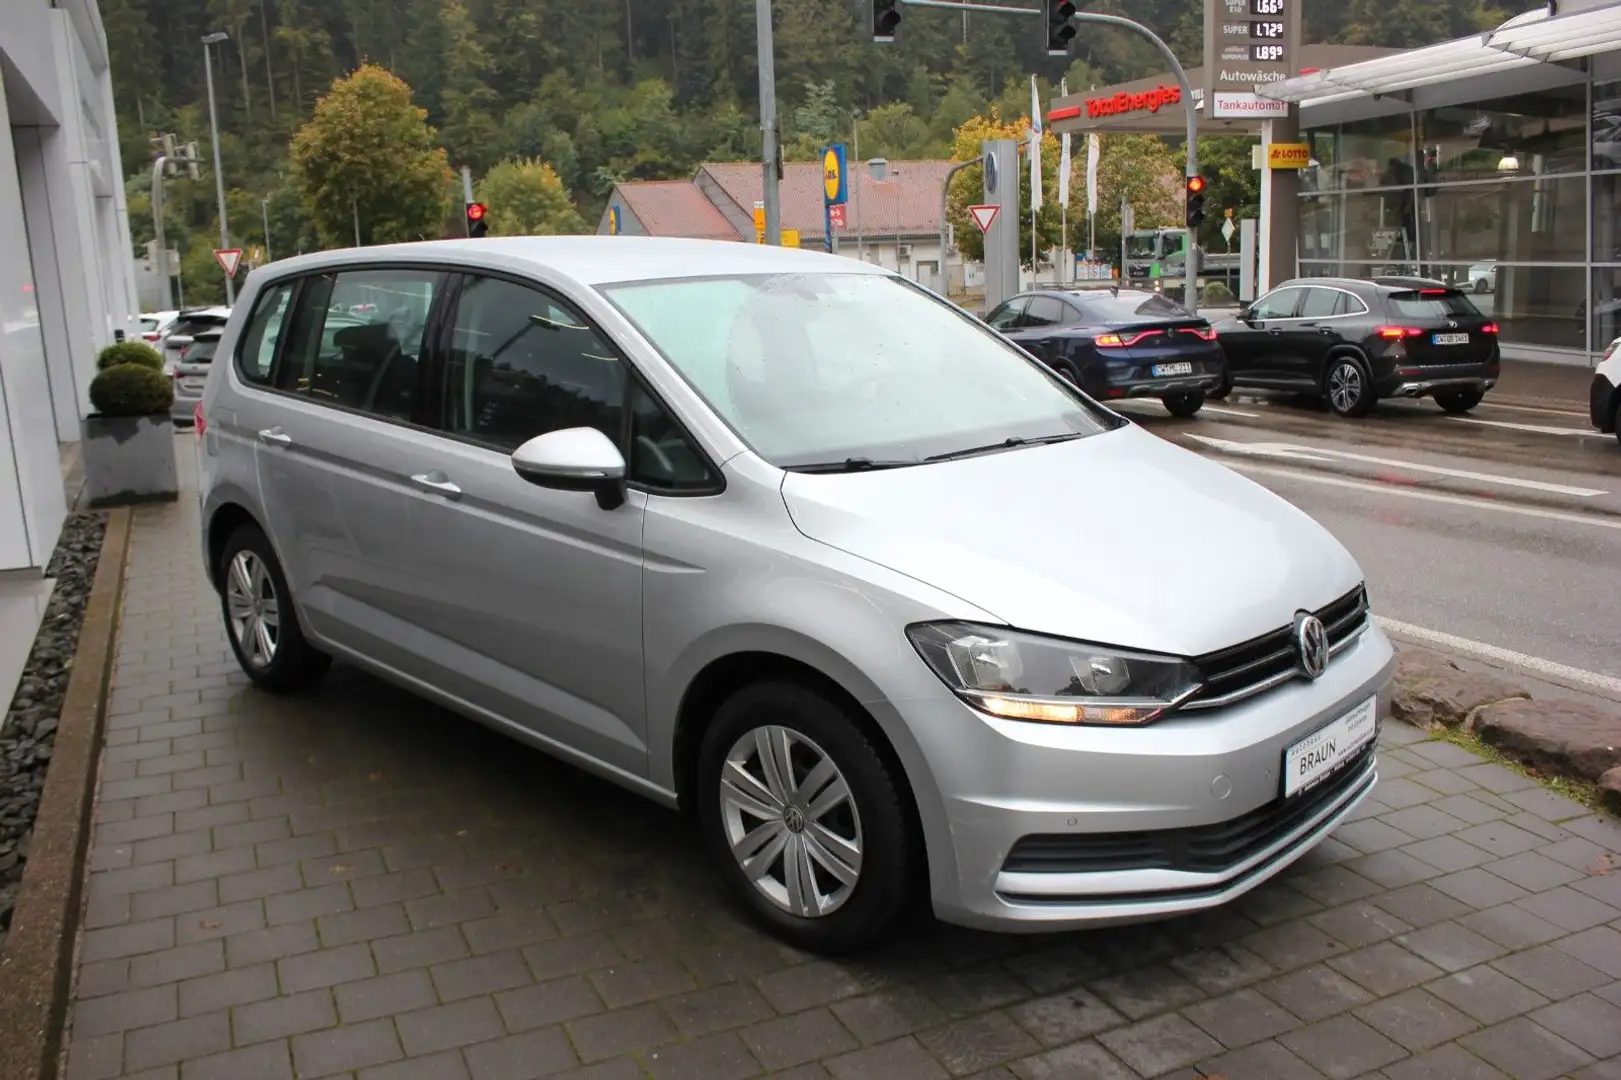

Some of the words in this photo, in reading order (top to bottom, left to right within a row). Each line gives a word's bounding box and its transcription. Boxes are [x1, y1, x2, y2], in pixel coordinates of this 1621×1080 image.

[1223, 25, 1248, 34] SUPER
[1220, 70, 1286, 82] Autowäsche
[1085, 84, 1181, 117] TotalEnergies
[1217, 100, 1286, 110] Tankautomat
[1282, 149, 1308, 159] LOTTO
[1300, 738, 1336, 775] BRAUN
